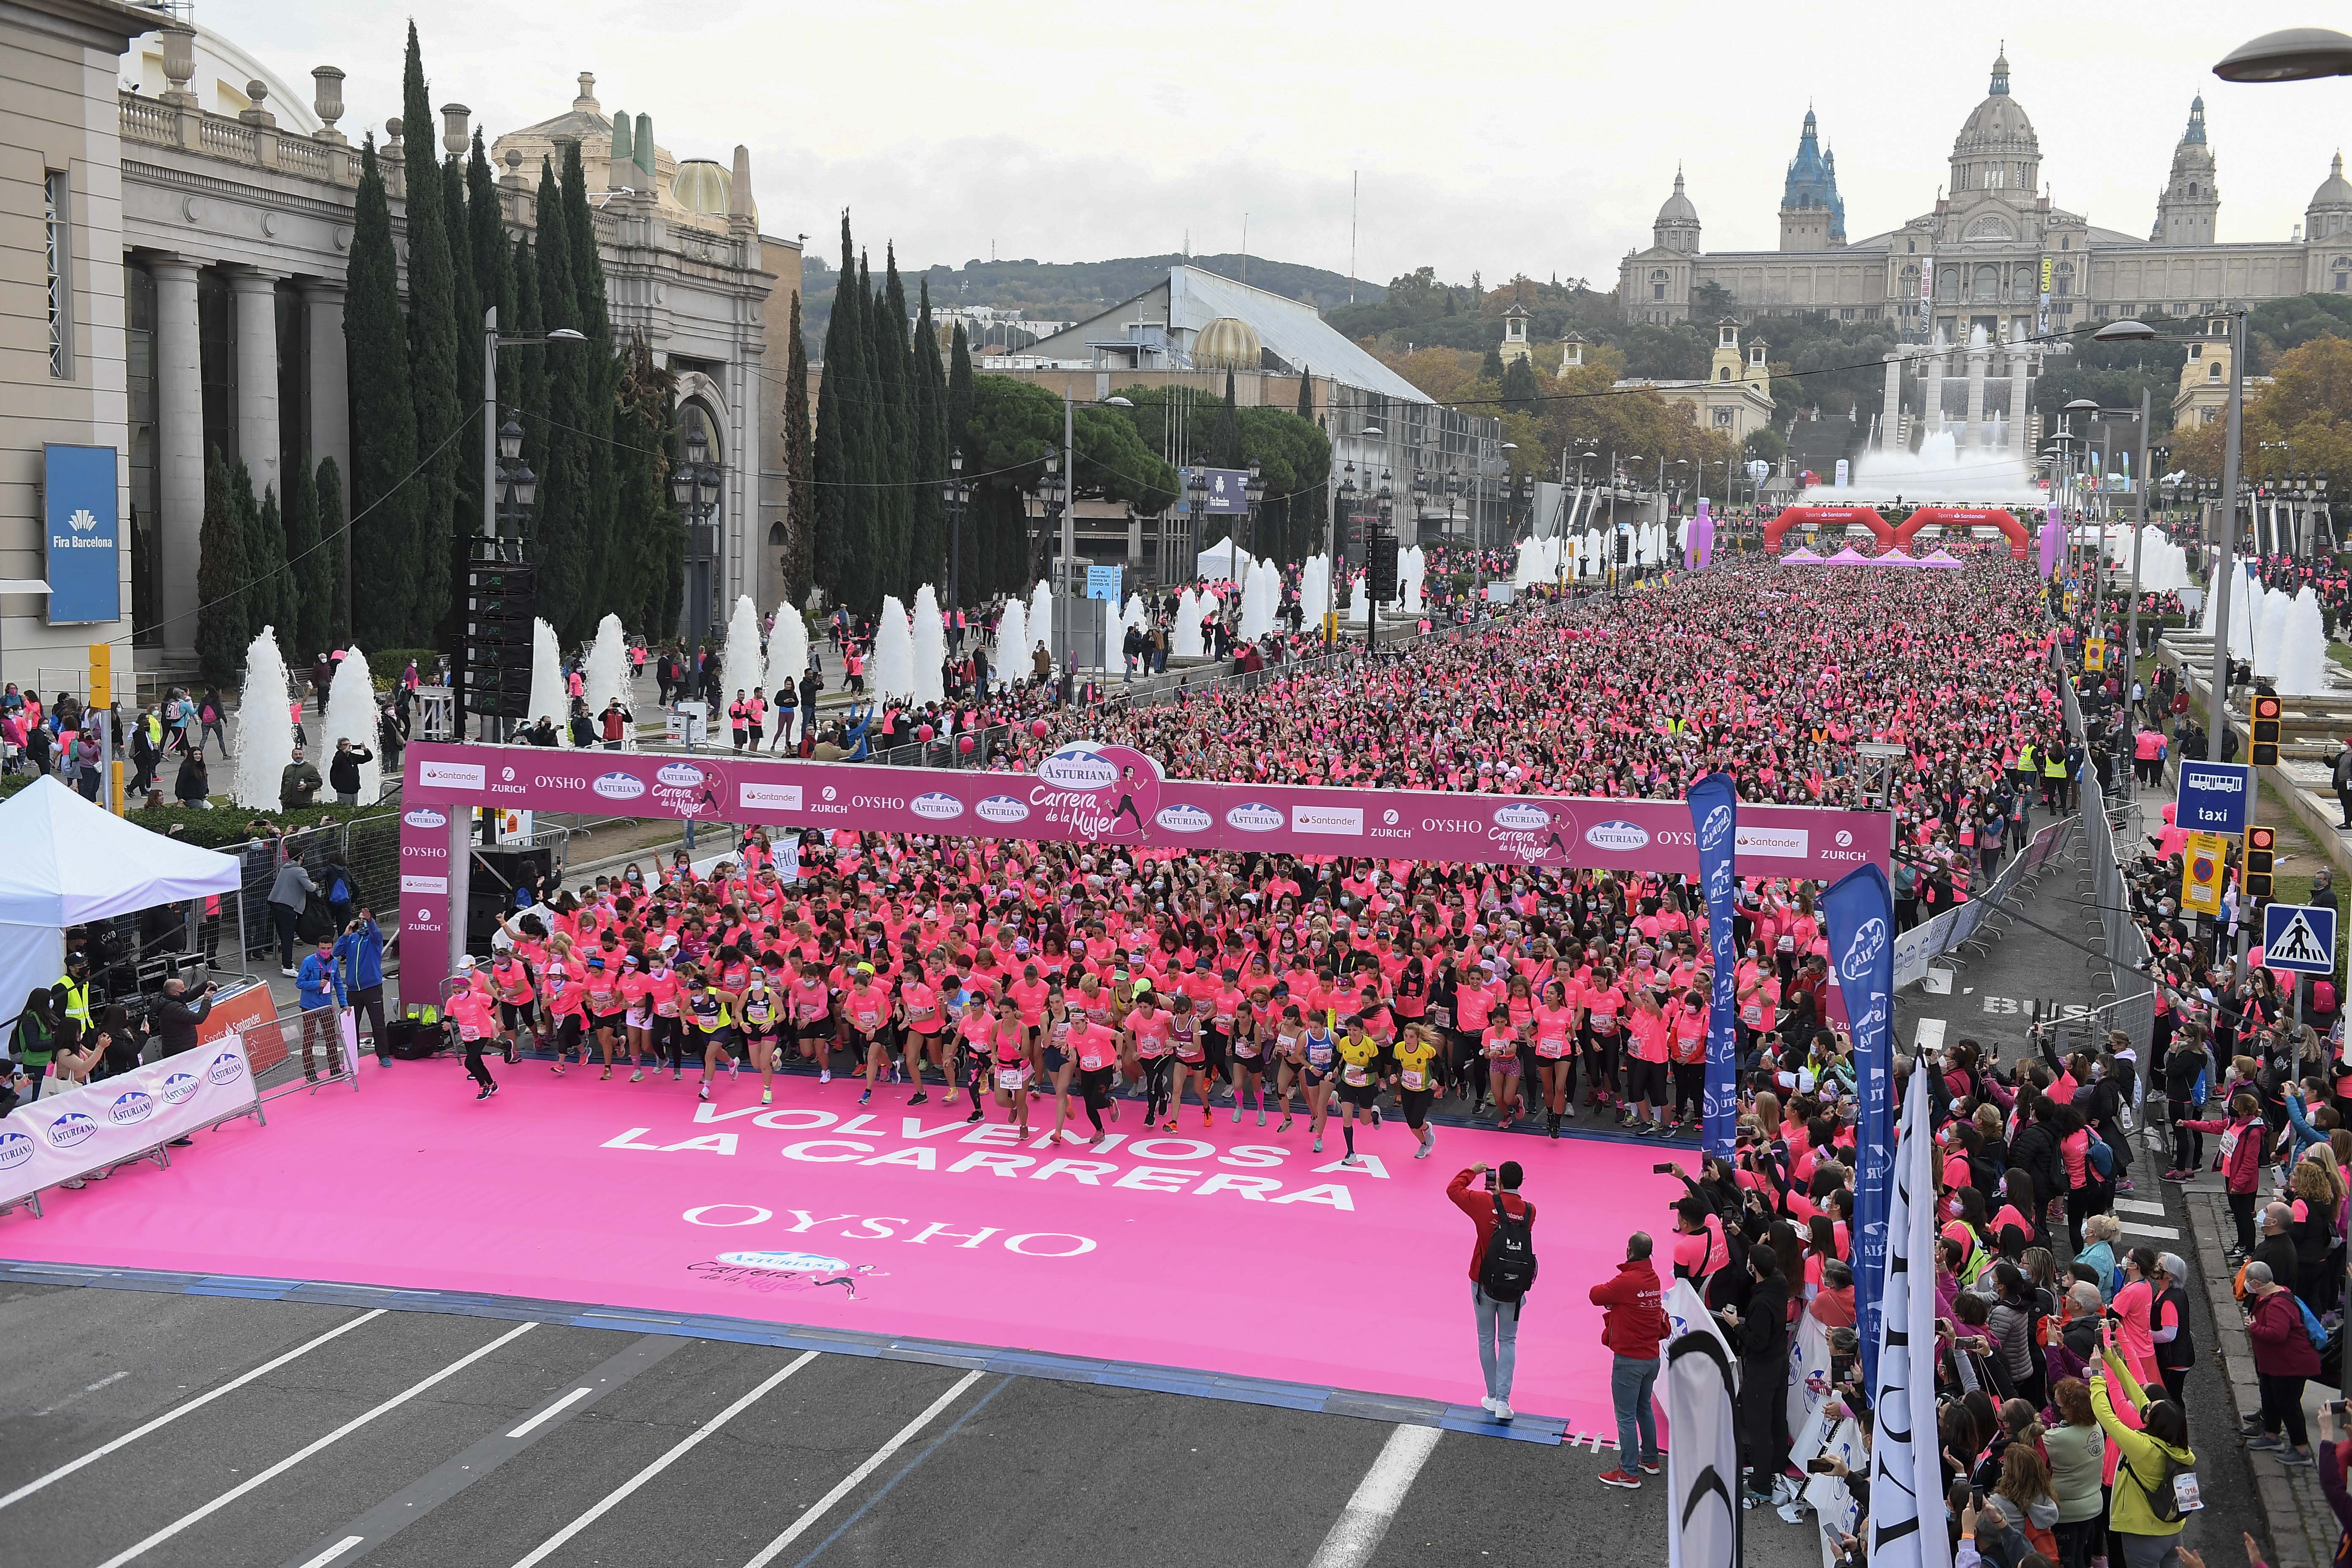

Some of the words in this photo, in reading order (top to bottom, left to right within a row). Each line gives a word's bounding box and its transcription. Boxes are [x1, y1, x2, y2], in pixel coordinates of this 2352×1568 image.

[54, 536, 69, 548] Fira
[72, 536, 112, 548] Barcelona
[438, 771, 479, 781] Santander
[660, 771, 700, 782] ASTURIANA
[1043, 763, 1112, 781] ASTURIANA
[491, 784, 526, 794] ZURICH
[535, 776, 586, 790] OYSHO
[596, 781, 641, 793] ASTURIANA
[652, 784, 691, 798] Carrera
[757, 792, 796, 802] Santander
[1030, 785, 1096, 809] Carrera
[661, 798, 668, 807] de
[670, 799, 676, 807] la
[674, 798, 706, 818] Mujer
[810, 804, 847, 814] ZURICH
[852, 795, 905, 810] OYSHO
[914, 801, 959, 814] ASTURIANA
[979, 806, 1025, 817] ASTURIANA
[1230, 812, 1280, 825] ASTURIANA
[1498, 812, 1546, 824] ASTURIANA
[2199, 807, 2227, 822] taxi
[407, 815, 444, 824] ASTURIANA
[1045, 807, 1058, 823] de
[1060, 808, 1070, 823] la
[1068, 807, 1121, 841] Mujer
[1160, 813, 1208, 826] ASTURIANA
[1311, 816, 1356, 826] Santander
[1422, 818, 1482, 833] OYSHO
[1370, 828, 1411, 838] ZURICH
[1488, 826, 1534, 842] Carrera
[1591, 833, 1645, 844] ASTURIANA
[1657, 831, 1696, 845] OYS
[1750, 836, 1800, 848] Santander
[403, 846, 447, 858] OYSHO
[773, 847, 797, 869] SHO
[1499, 840, 1508, 851] de
[1509, 842, 1516, 852] la
[1514, 841, 1552, 864] Mujer
[1821, 849, 1866, 861] ZURICH
[1984, 996, 2099, 1022] BUS
[233, 1013, 261, 1034] Santander
[211, 1063, 242, 1081] ASTURIANA
[113, 1102, 151, 1122] ASTURIANA
[52, 1123, 95, 1144] ASTURIANA
[694, 1103, 1290, 1167] VOLVEMOS
[1311, 1154, 1390, 1179] A
[599, 1127, 739, 1155] LA
[782, 1141, 1355, 1211] CARRERA
[682, 1204, 1097, 1257] OYSHO
[730, 1253, 835, 1271] ASTURIANA
[687, 1261, 798, 1279] Carrera
[2185, 1486, 2197, 1495] 016
